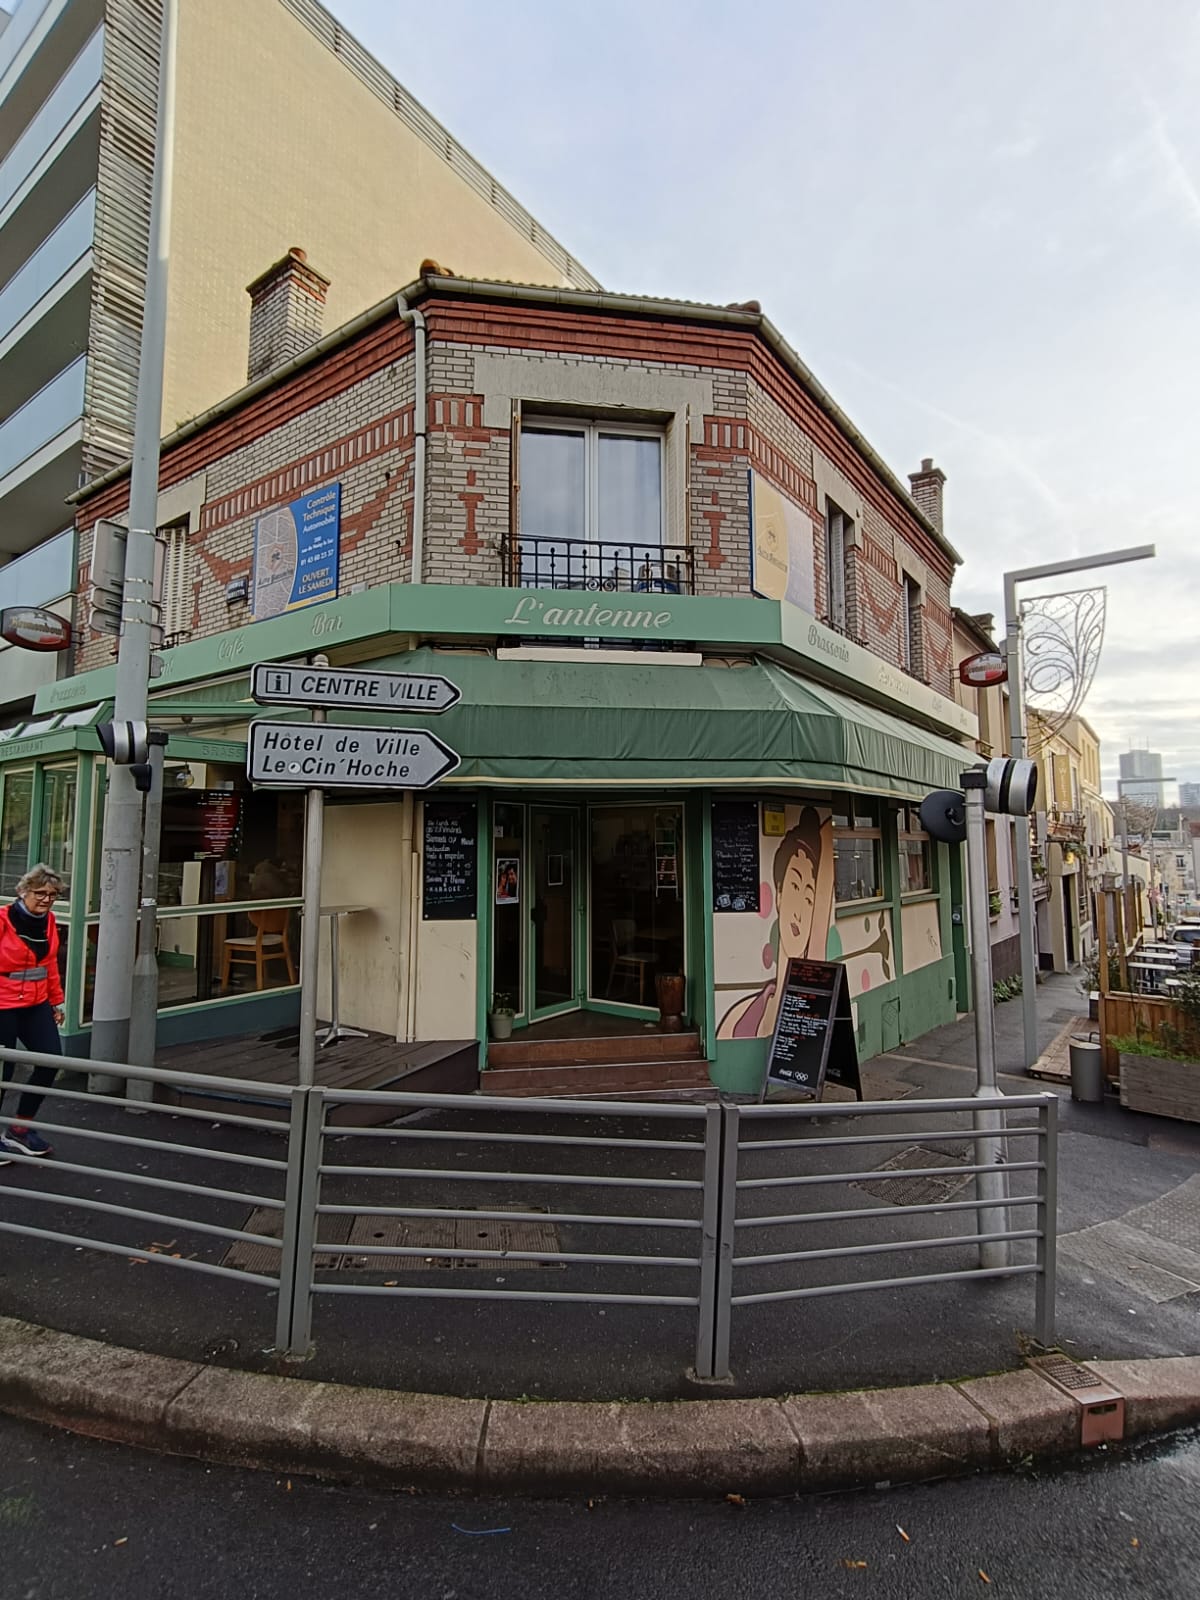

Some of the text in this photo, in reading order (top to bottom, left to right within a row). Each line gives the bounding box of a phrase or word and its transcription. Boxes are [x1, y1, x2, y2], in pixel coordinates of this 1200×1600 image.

[307, 490, 336, 509] Contrôle
[302, 504, 336, 522] Technique
[302, 515, 336, 534] Automobile
[298, 583, 306, 595] LE
[306, 576, 333, 592] SAMEDI
[302, 567, 330, 583] OUVERT
[504, 595, 671, 629] L'antenne
[312, 612, 342, 637] Bar
[218, 634, 244, 661] Café
[808, 624, 849, 663] Brasserie
[301, 675, 438, 701] CENTRE VILLE
[263, 732, 420, 756] Hôtel de Ville
[262, 755, 410, 778] Le Cin'Hoche
